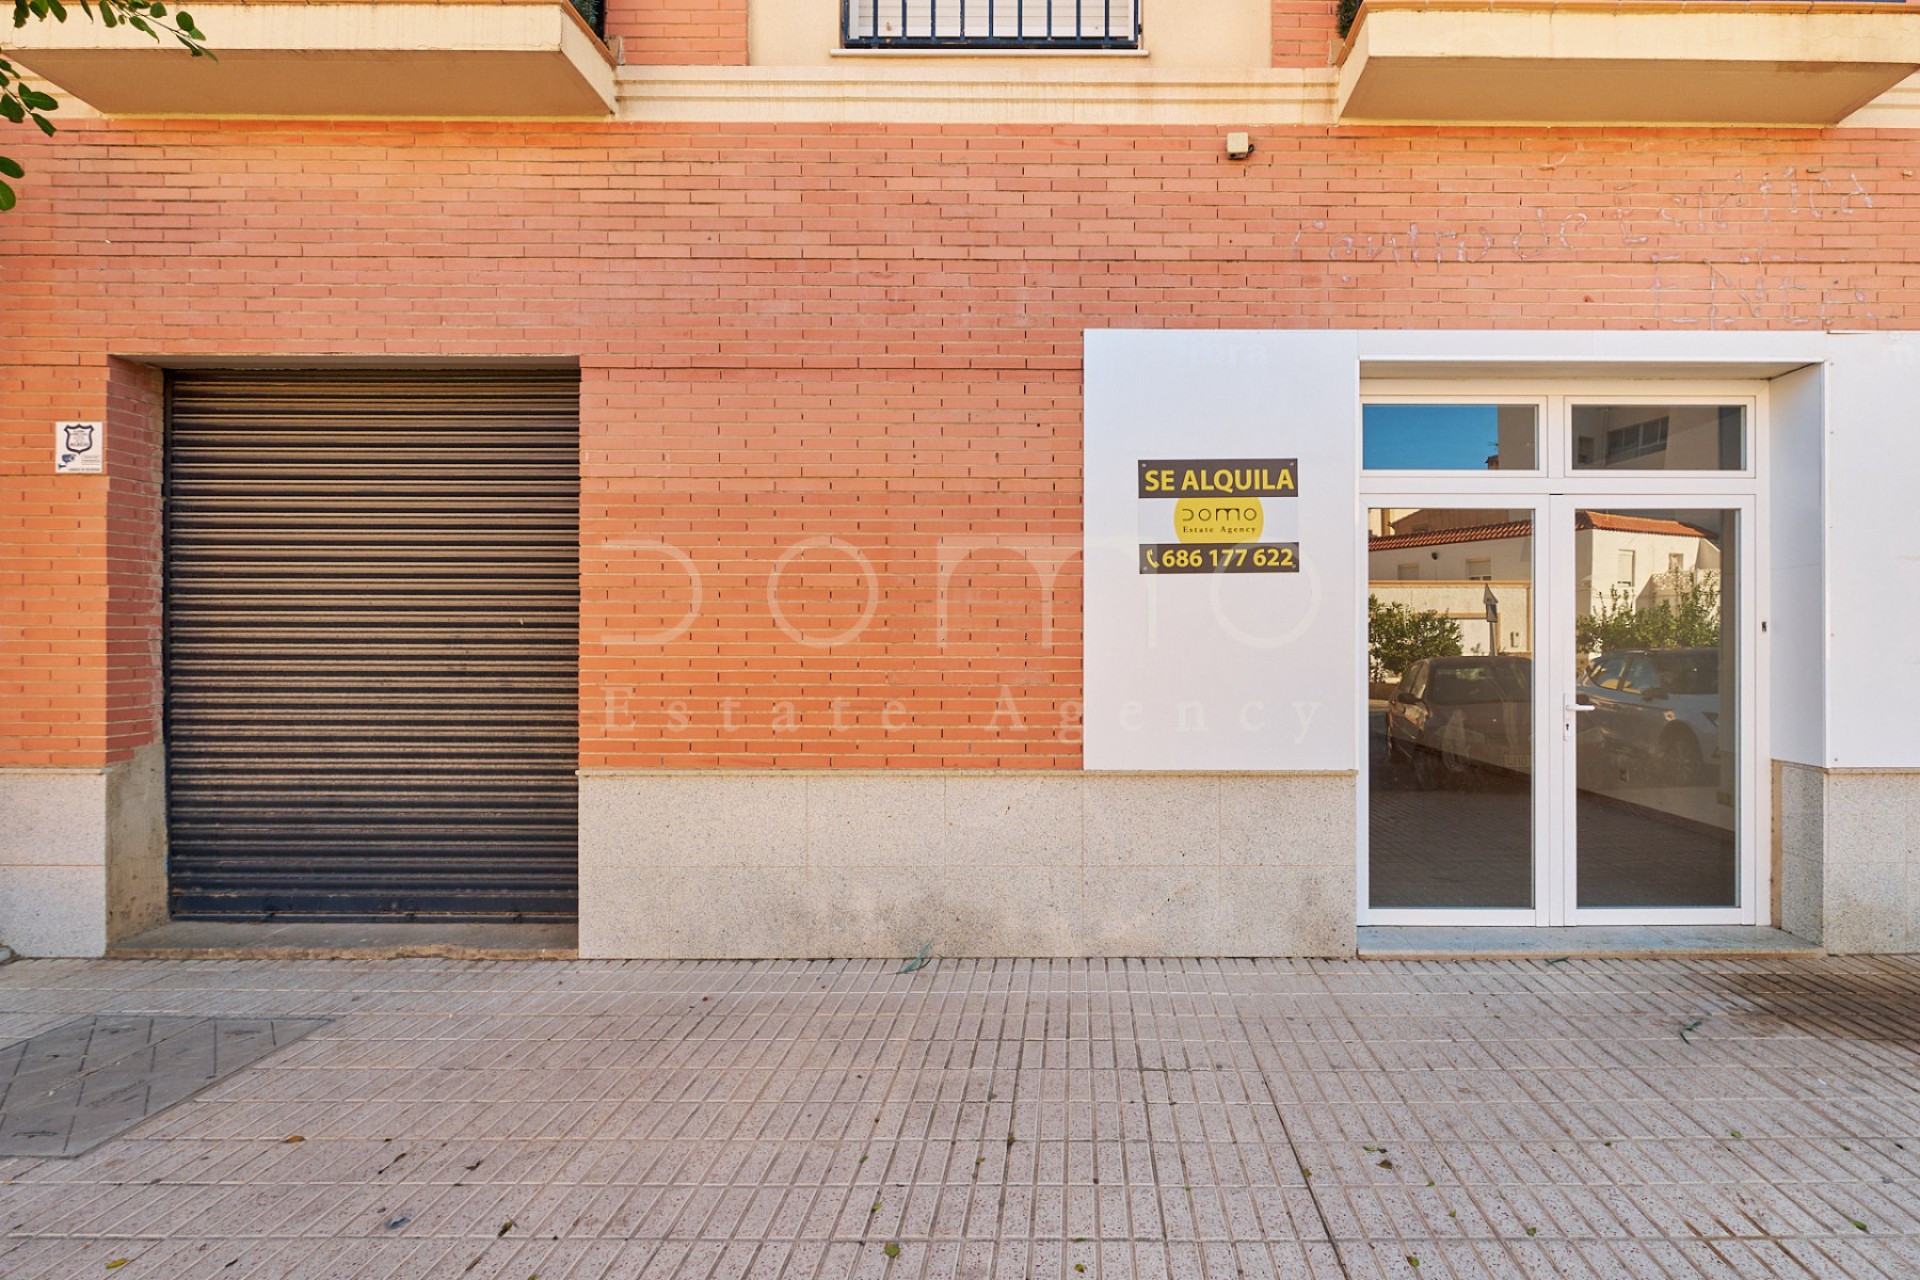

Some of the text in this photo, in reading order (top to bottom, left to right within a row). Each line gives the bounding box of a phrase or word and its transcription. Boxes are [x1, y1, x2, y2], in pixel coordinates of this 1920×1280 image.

[1144, 468, 1295, 494] SE ALQUILA
[1183, 525, 1257, 535] Estate Agency
[1162, 548, 1294, 567] 686 177 622
